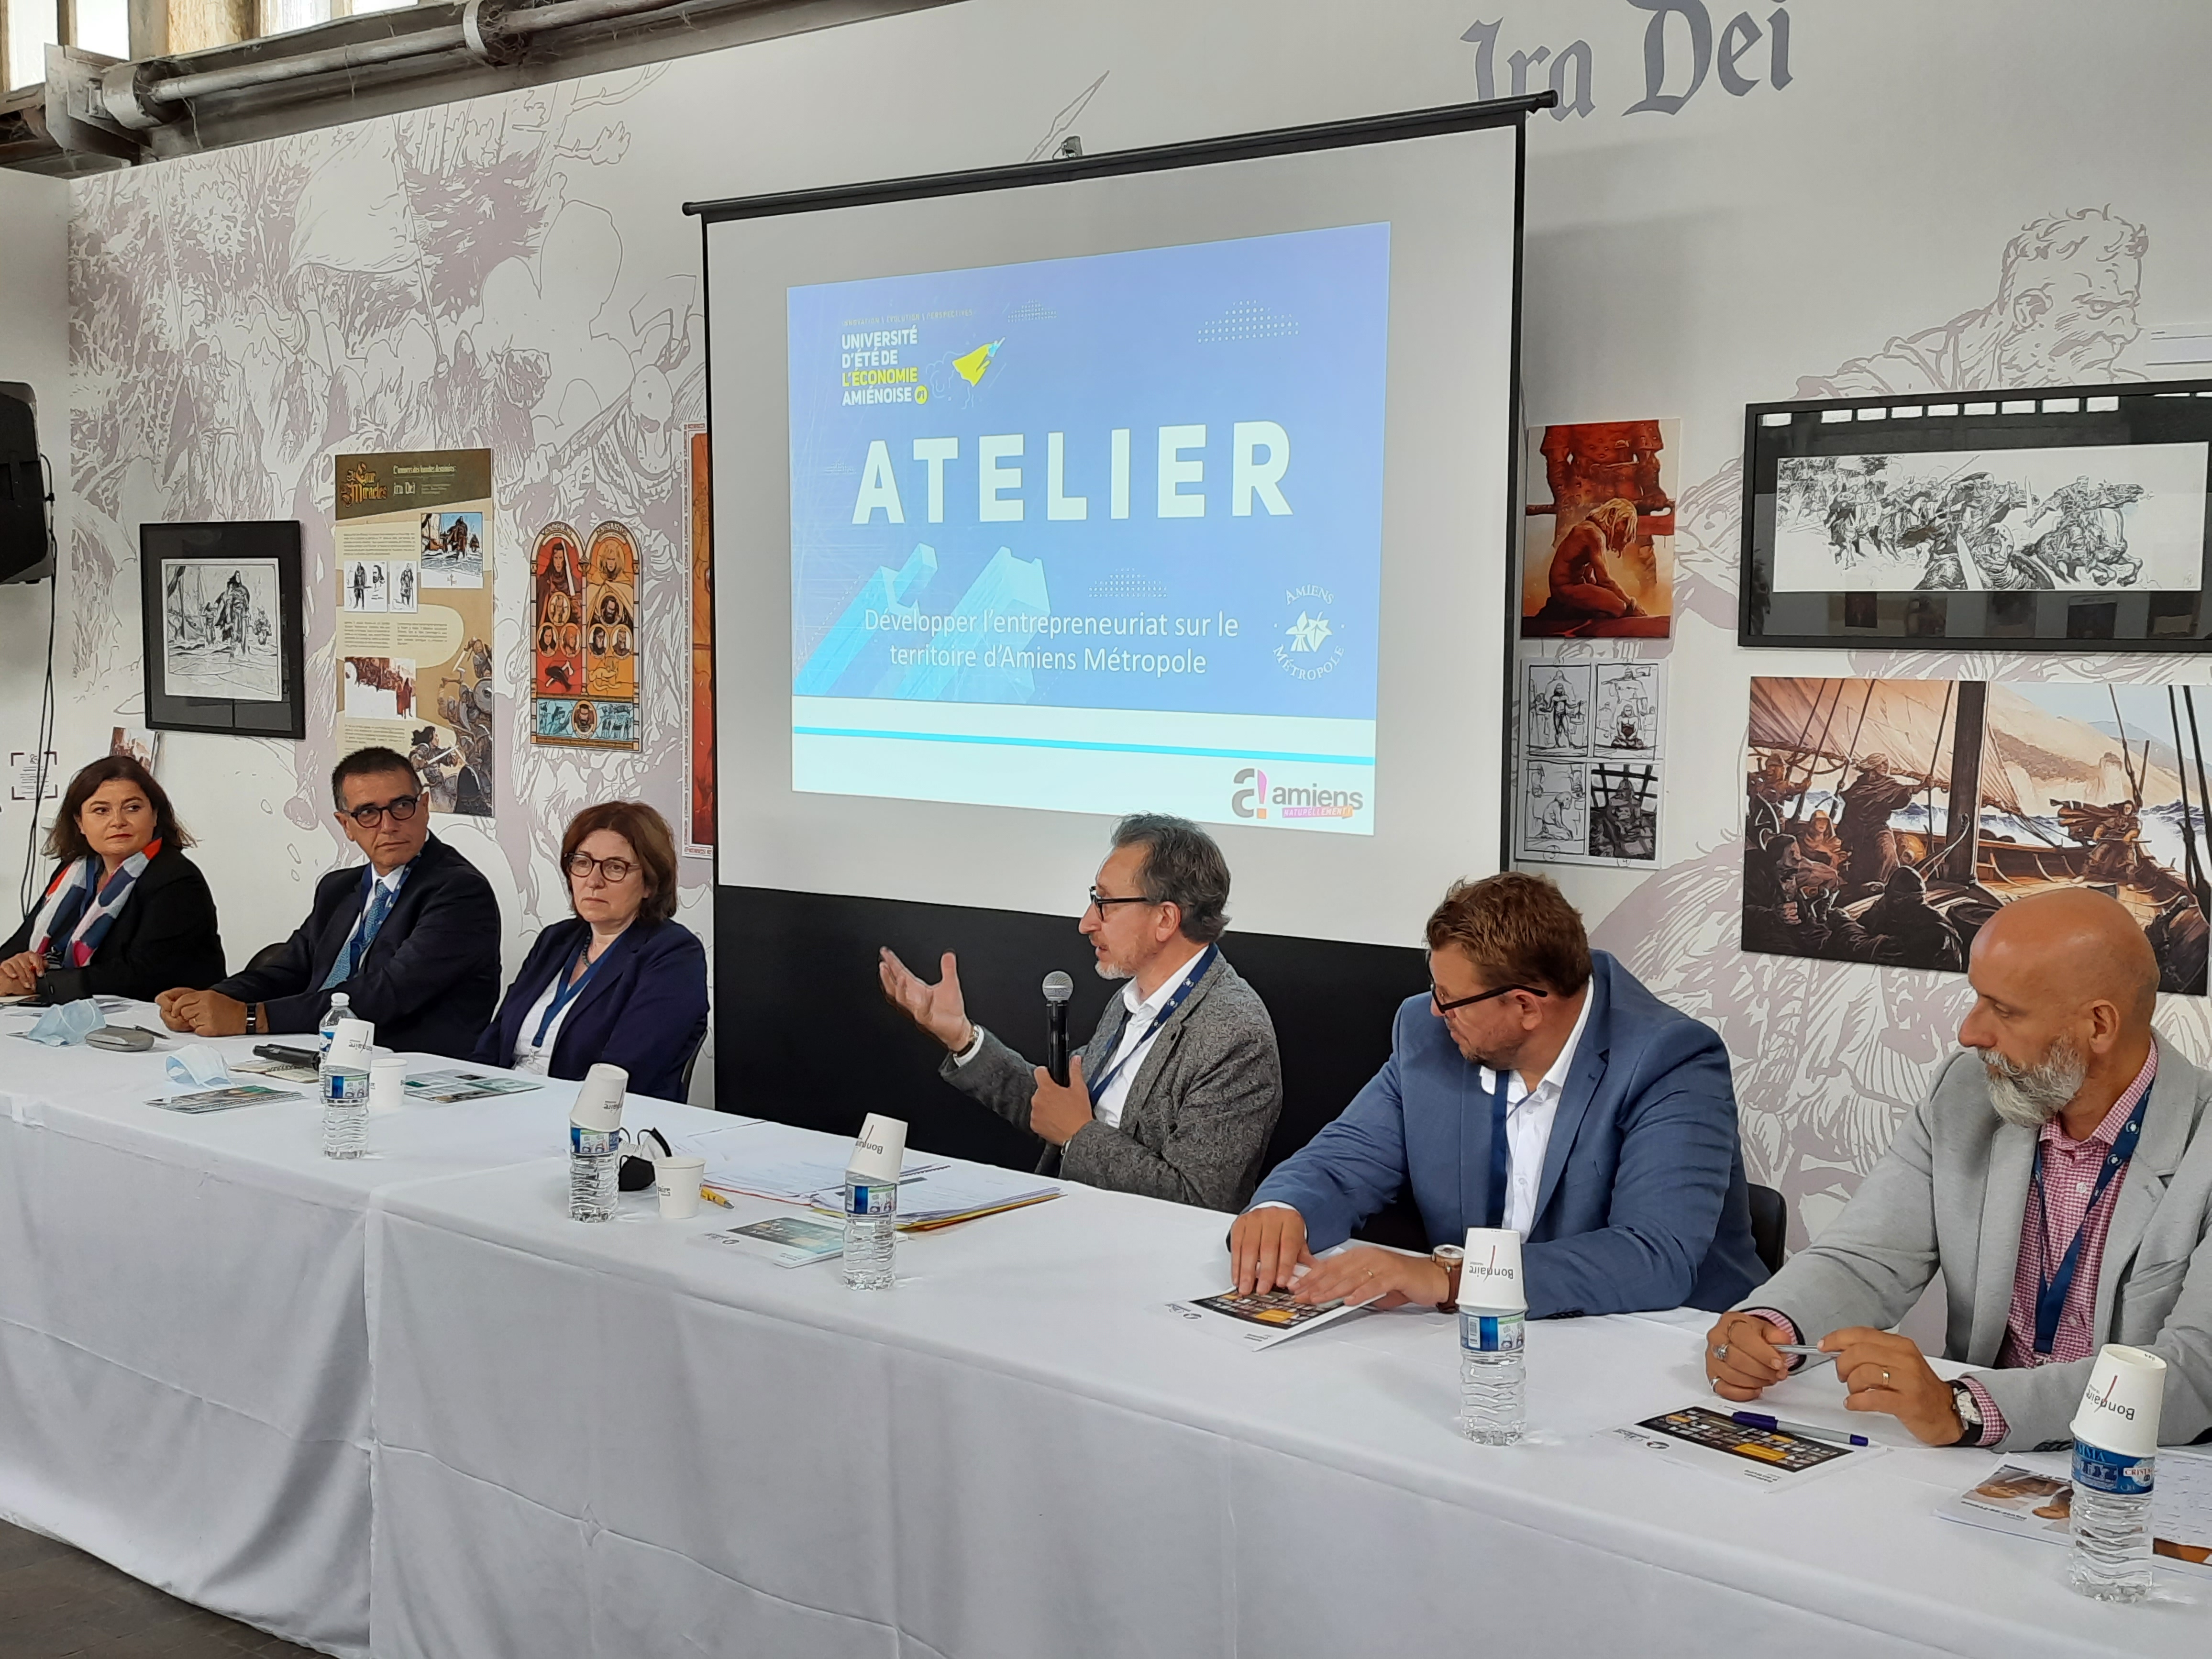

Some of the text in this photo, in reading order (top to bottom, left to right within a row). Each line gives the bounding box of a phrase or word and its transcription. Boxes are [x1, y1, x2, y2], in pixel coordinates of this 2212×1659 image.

[1459, 0, 1794, 122] Ira Dei
[926, 309, 973, 320] PERSPECTIVES
[841, 324, 918, 350] UNIVERSITÉ
[842, 347, 898, 369] D'ÉTÉ DE
[842, 367, 918, 387] L'ÉCONOMIE
[842, 385, 912, 406] AMIÉNOISE
[852, 420, 1294, 525] ATELIER
[1285, 584, 1334, 606] AMIENS
[864, 608, 1239, 640] Développer l'entrepreneuriat sur le
[890, 644, 1207, 679] territoire d'Amiens Métropole
[1272, 643, 1345, 681] MÉTROPOLE
[1272, 783, 1363, 810] amiens
[1469, 1265, 1514, 1279] Bonnaire
